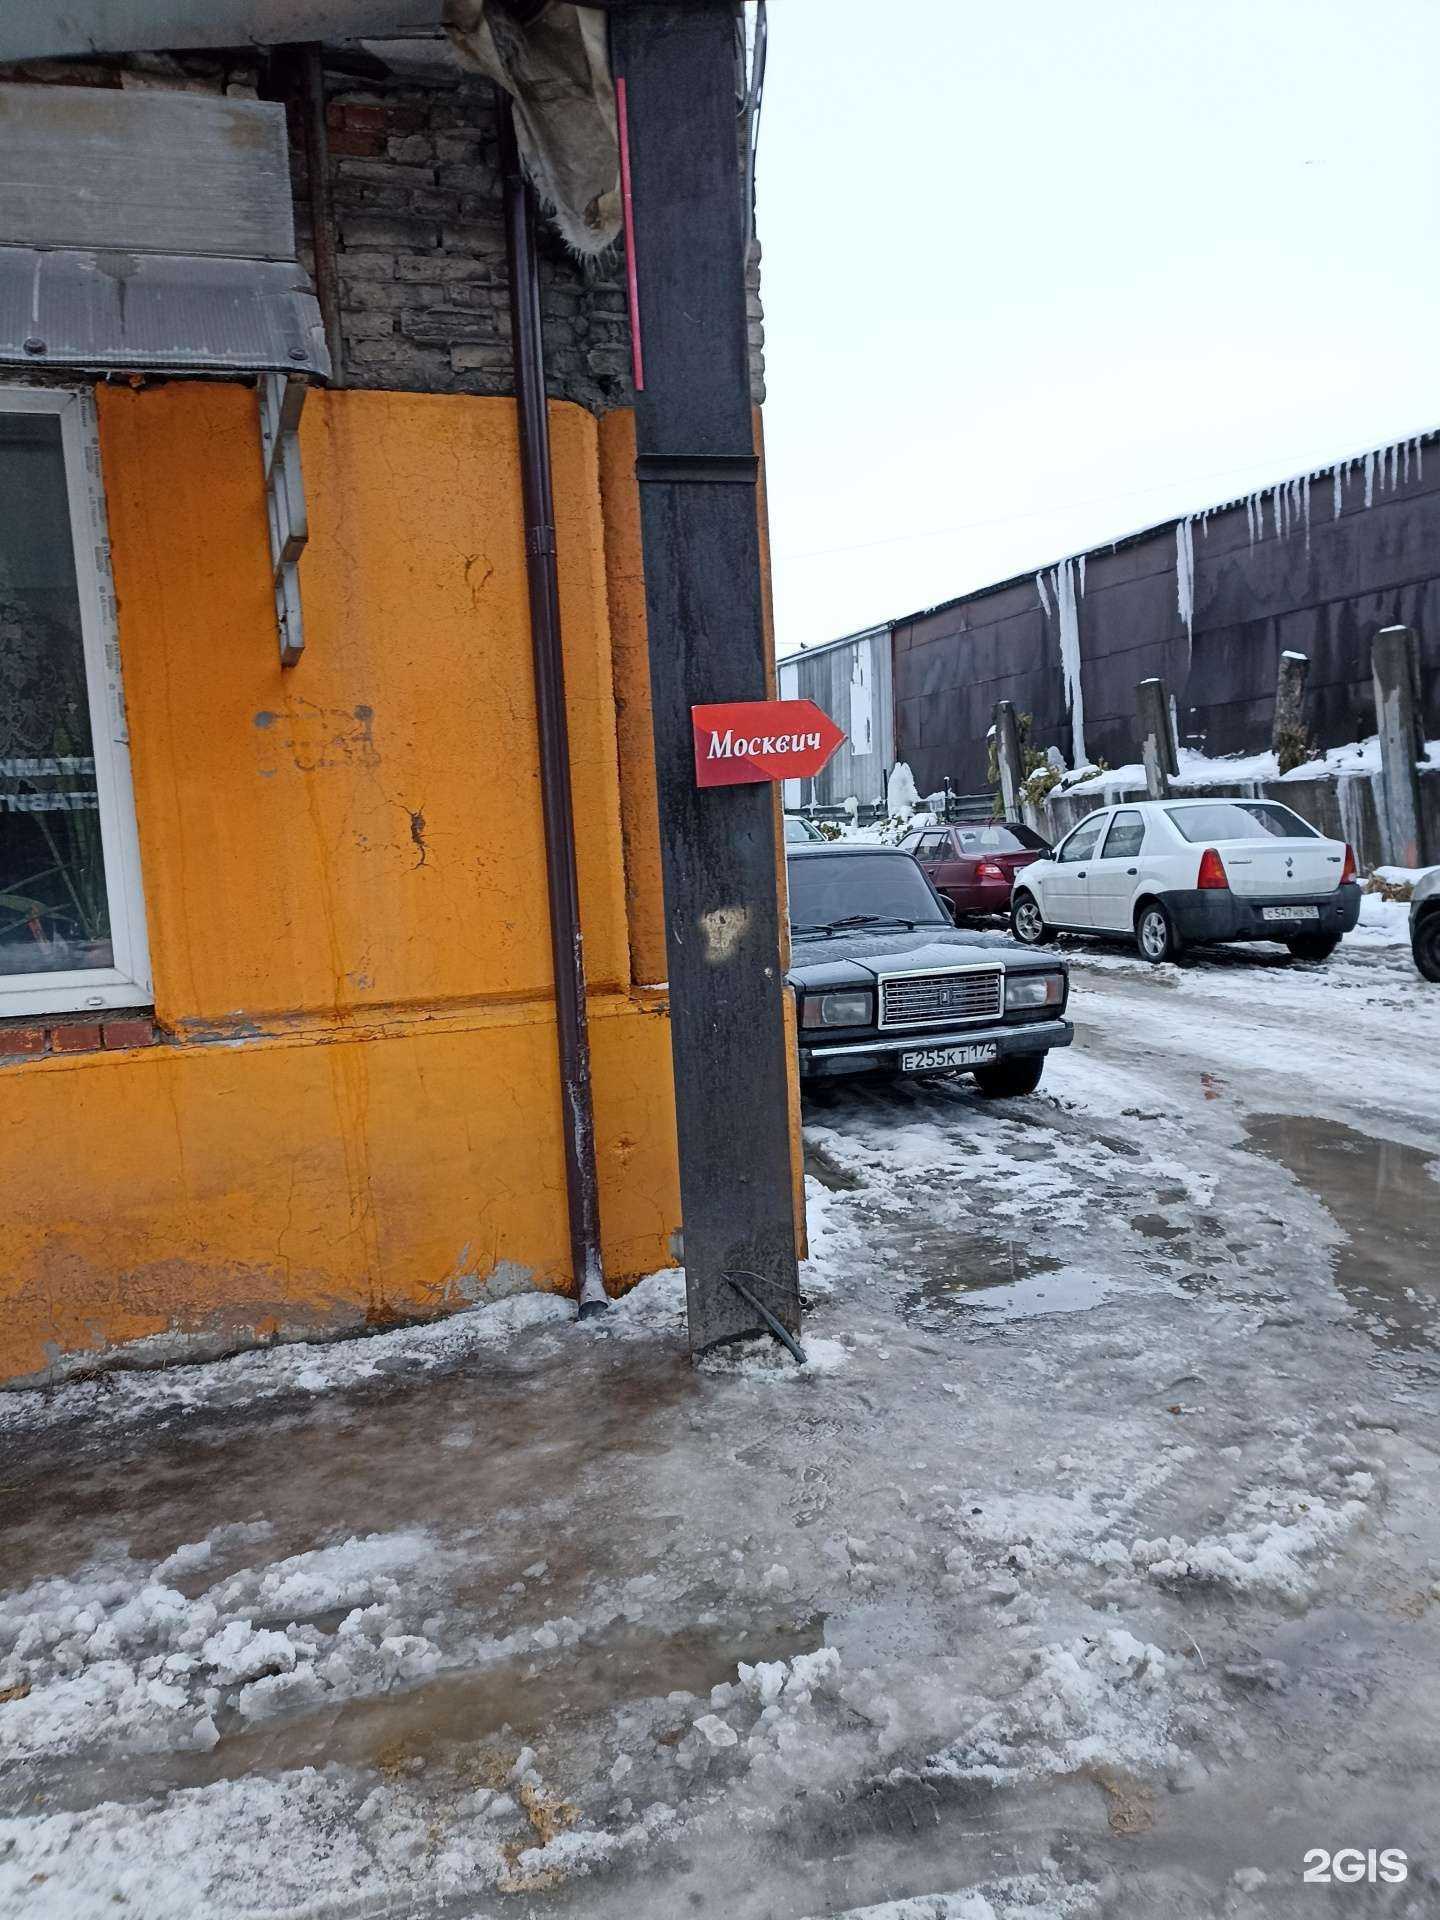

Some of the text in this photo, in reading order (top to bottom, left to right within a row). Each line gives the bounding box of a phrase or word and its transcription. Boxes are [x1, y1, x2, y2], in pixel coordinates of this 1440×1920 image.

[706, 729, 822, 760] Москвич
[904, 1044, 996, 1070] Е255КТ 174
